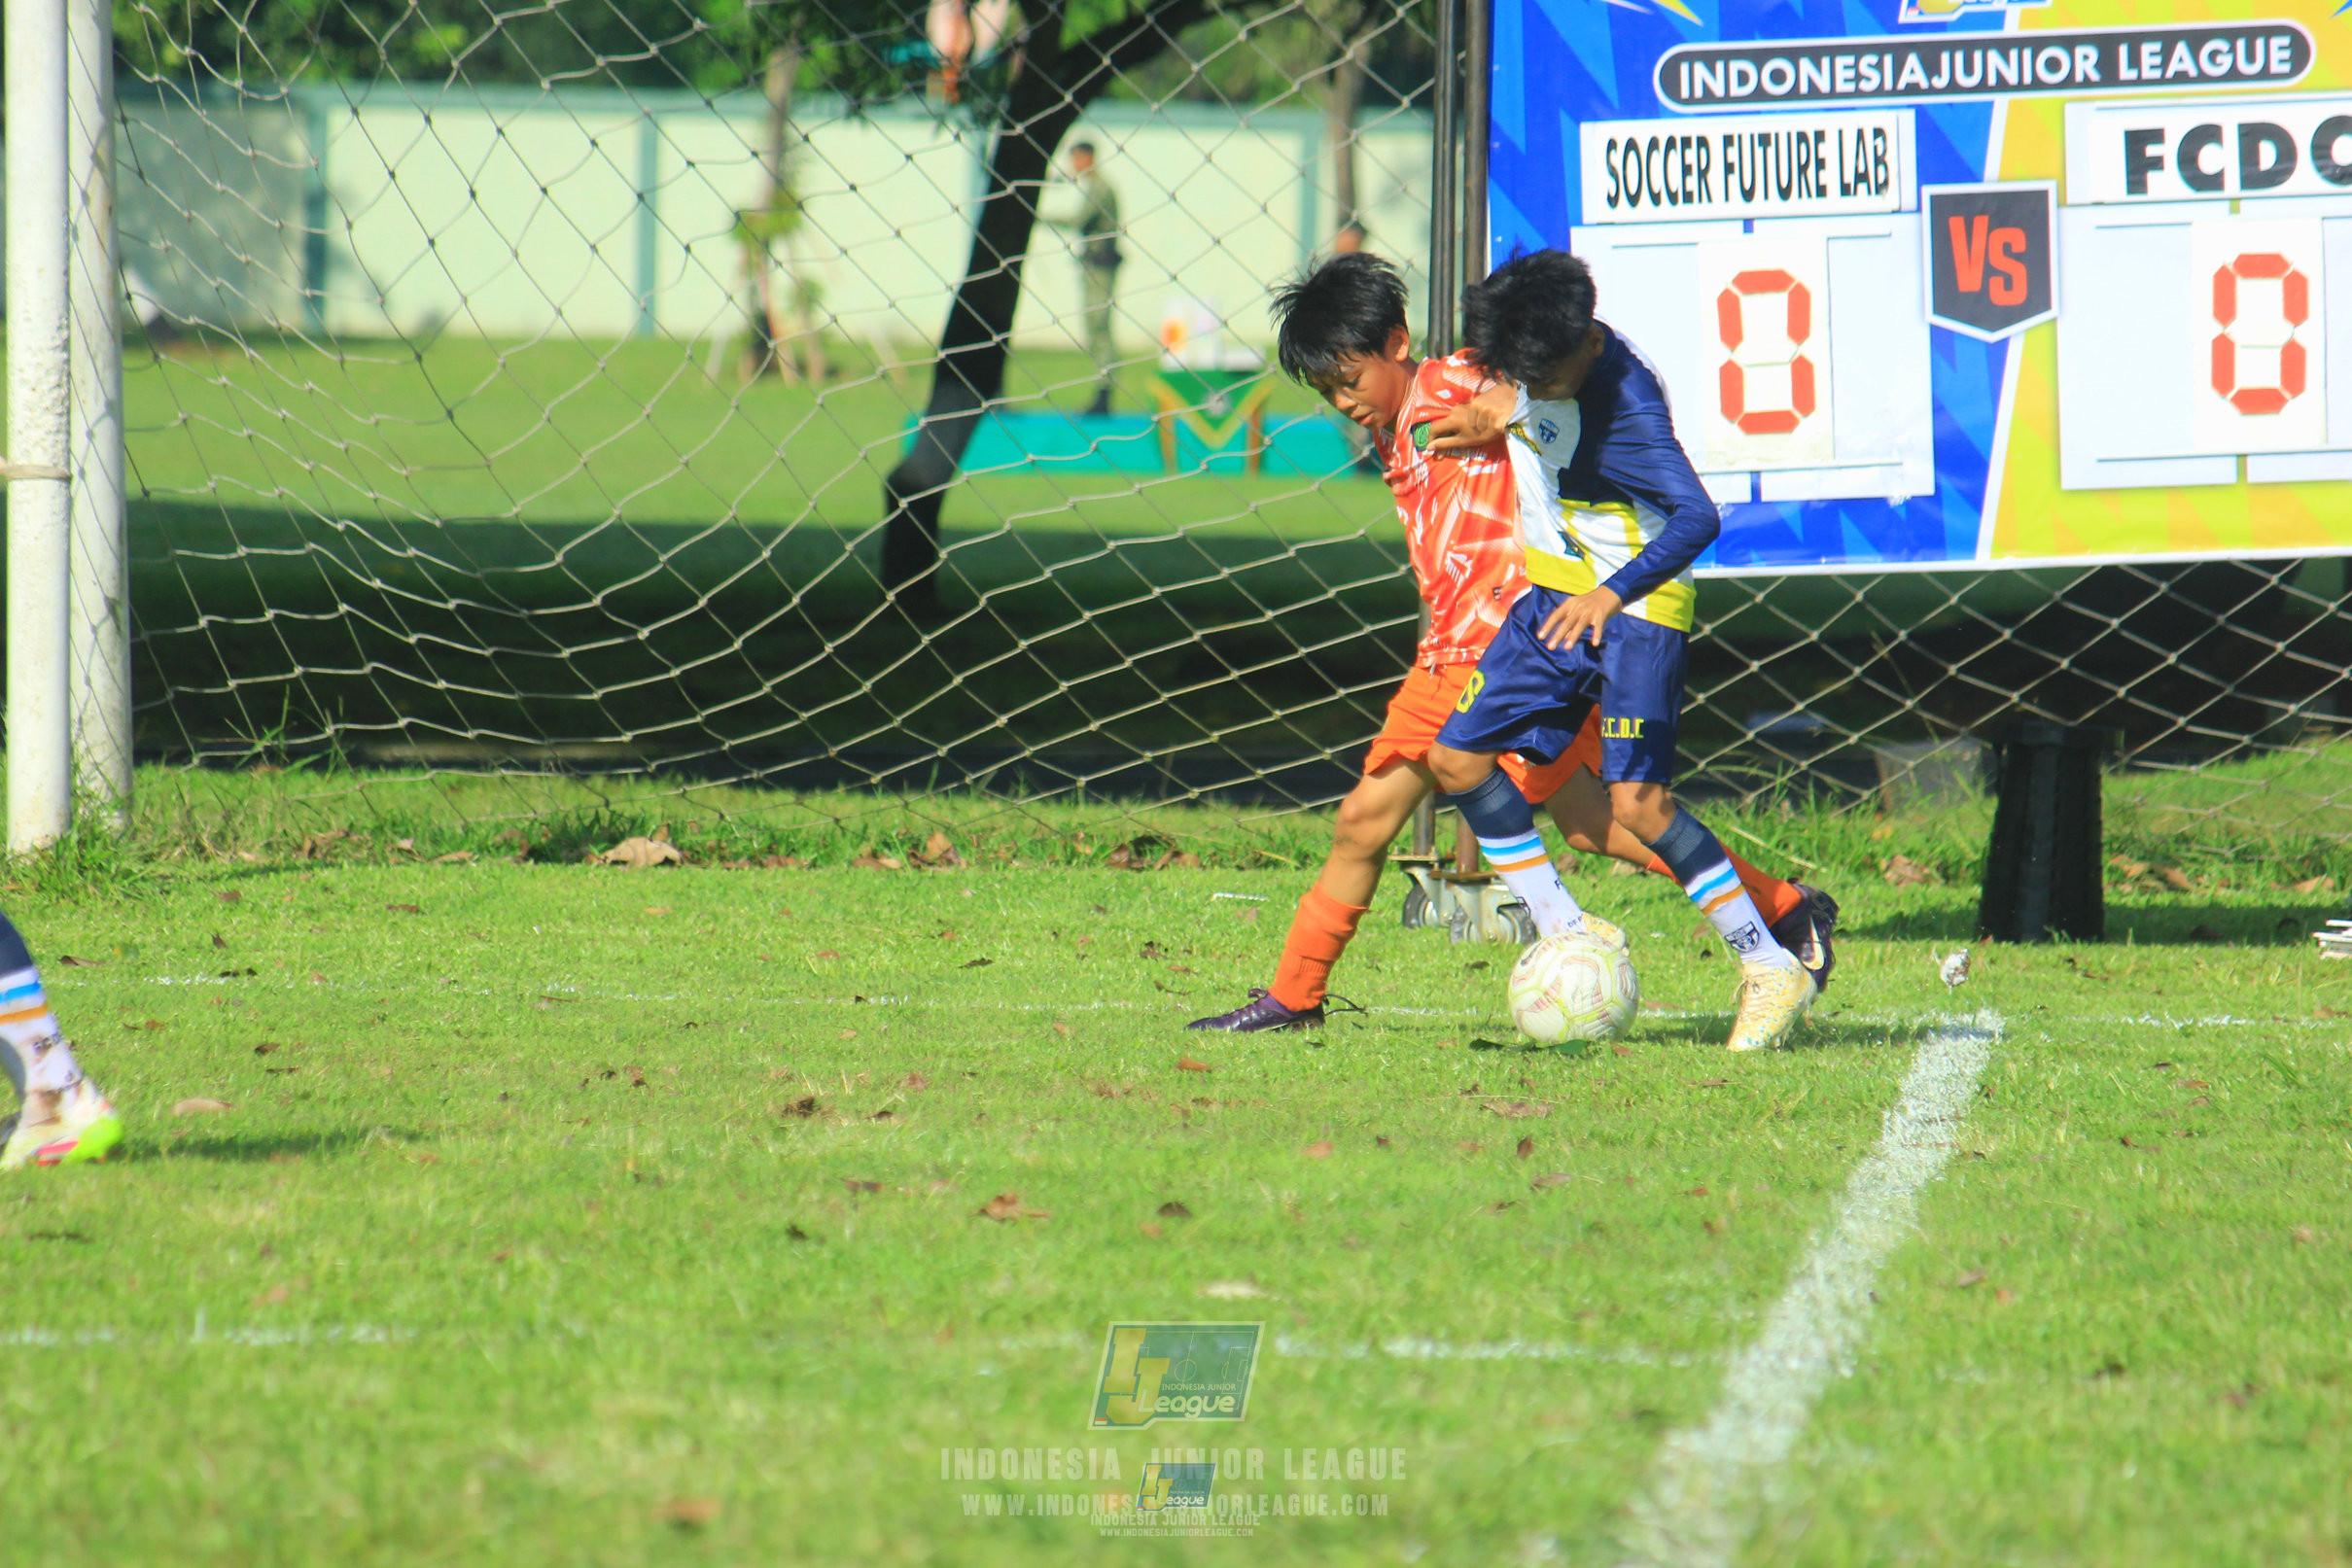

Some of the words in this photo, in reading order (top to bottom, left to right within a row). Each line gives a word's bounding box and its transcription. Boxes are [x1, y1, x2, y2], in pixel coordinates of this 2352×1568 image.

[2118, 35, 2293, 82] LEAGUE
[1606, 134, 1712, 209] SOCCER
[1723, 129, 1827, 203] FUTURE
[1838, 126, 1890, 197] LAB
[1948, 215, 2027, 306] VS
[1716, 269, 1816, 435] 0
[2211, 253, 2308, 415] 0
